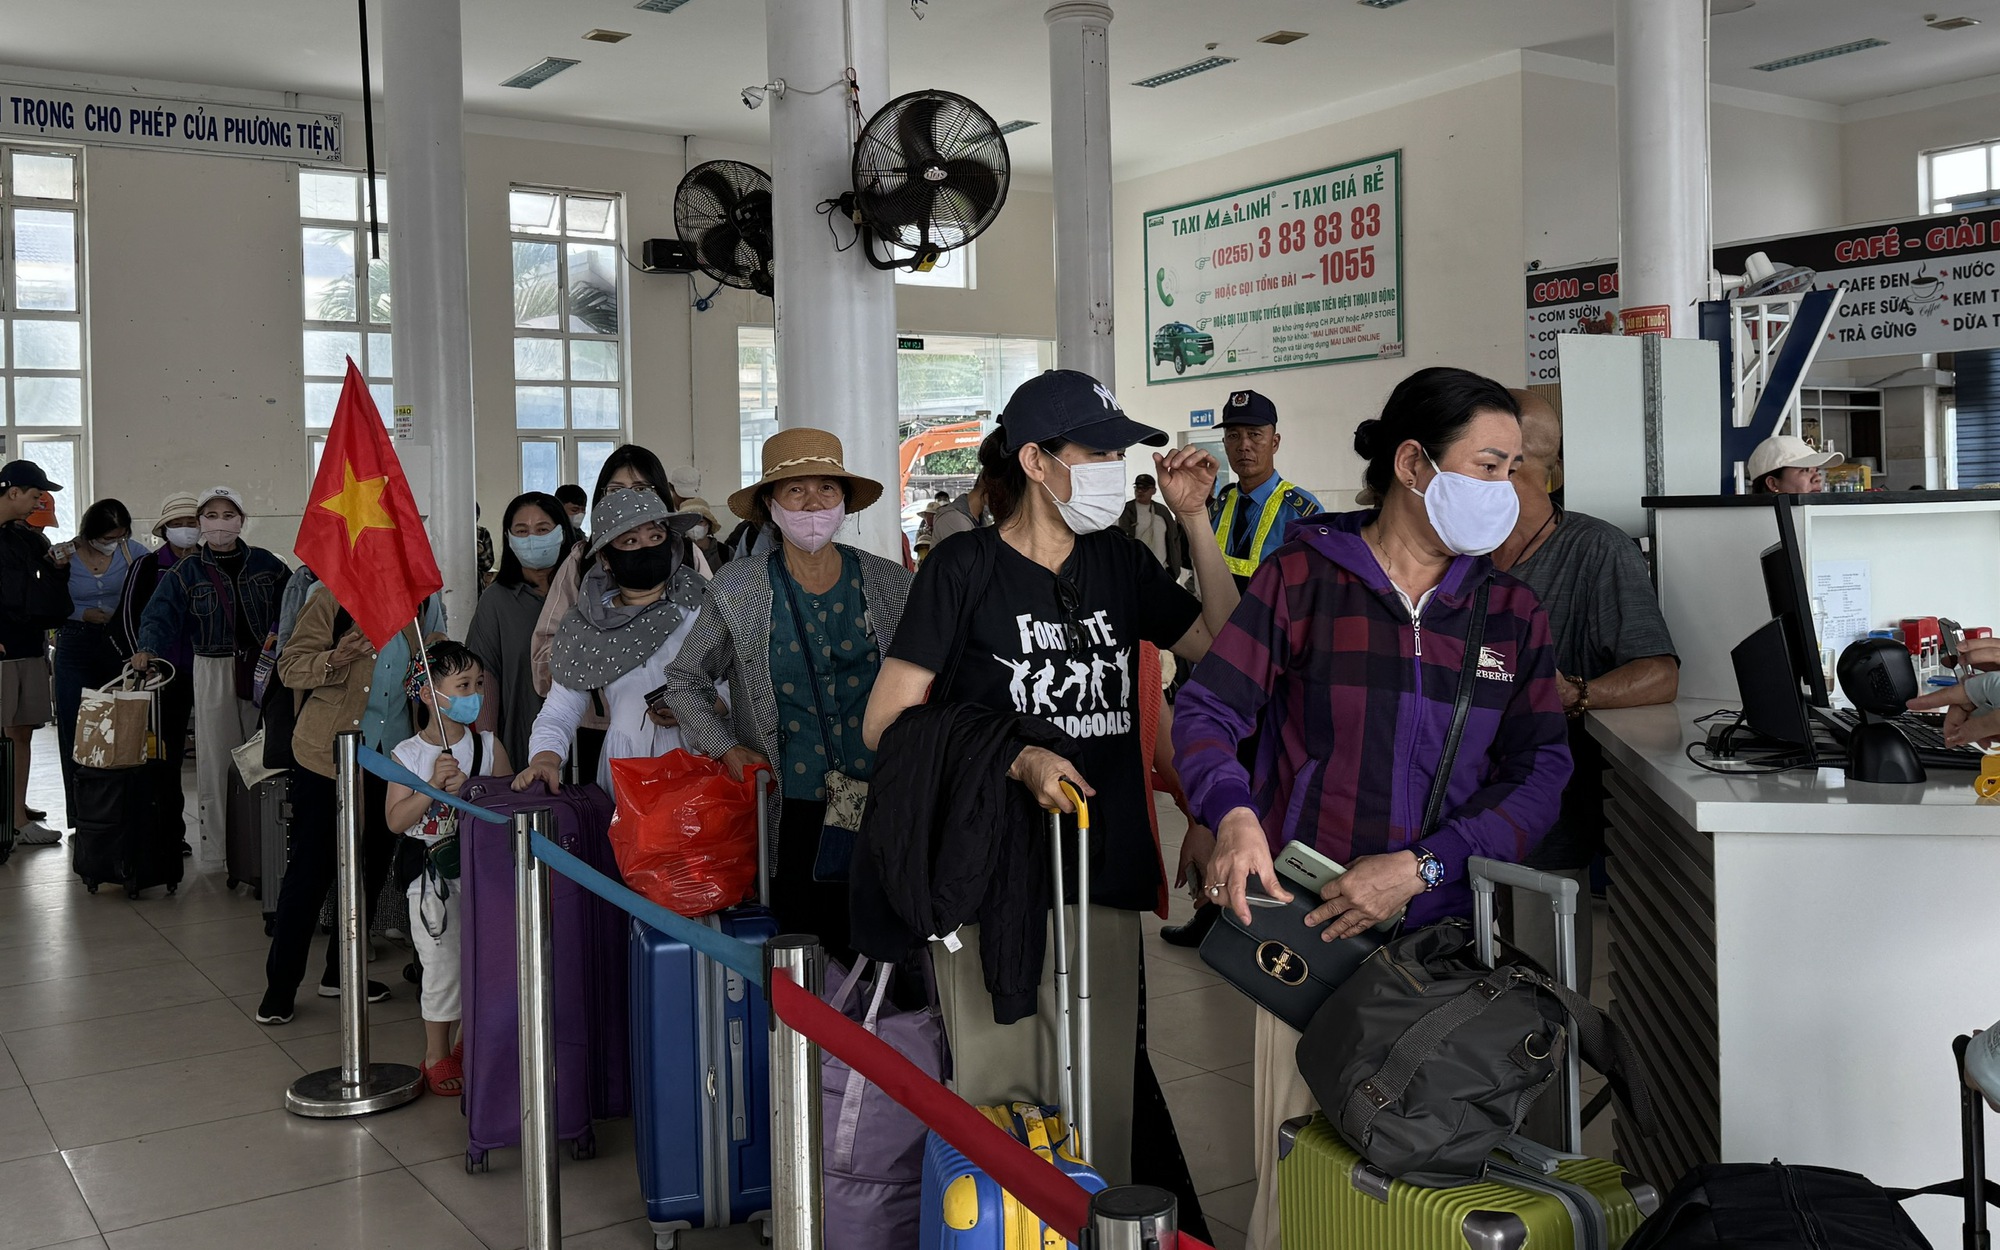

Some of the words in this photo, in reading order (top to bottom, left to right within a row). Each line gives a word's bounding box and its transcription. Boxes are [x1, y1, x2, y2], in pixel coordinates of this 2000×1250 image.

[10, 97, 75, 133] TRỌNG
[84, 103, 122, 134] CHO
[129, 106, 177, 137] PHÉP
[183, 106, 219, 142] CỦA
[224, 115, 292, 148] PHƯƠNG
[297, 119, 335, 155] TIỆN
[1172, 214, 1200, 237] TAXI
[1293, 185, 1327, 210] TAXI
[1332, 173, 1357, 201] GIÁ
[1363, 165, 1384, 194] RẺ
[1212, 242, 1254, 269] (0255)
[1258, 226, 1271, 258] 3
[1278, 219, 1306, 254] 83
[1314, 211, 1342, 247] 83
[1350, 203, 1381, 240] 83
[1835, 227, 1900, 263] CAFÉ
[1925, 217, 1985, 251] GIẢI
[1319, 245, 1375, 286] 1055
[1952, 260, 1995, 280] NƯỚC
[1533, 277, 1579, 302] CƠM
[1839, 276, 1875, 294] CAFE
[1880, 272, 1910, 289] ĐEN
[1839, 301, 1876, 318] CAFE
[1880, 296, 1910, 314] SỮA
[1953, 290, 1986, 307] KEM
[1329, 316, 1345, 325] PLAY
[1360, 311, 1374, 321] APP
[1374, 308, 1396, 319] STORE
[1538, 308, 1566, 323] CƠM
[1569, 304, 1601, 320] SƯỜN
[1953, 313, 1988, 331] DỪA
[1325, 327, 1338, 337] LINH
[1342, 336, 1356, 344] LINH
[1357, 333, 1380, 342] ONLINE
[1538, 328, 1566, 342] CƠ
[1839, 323, 1866, 343] TRÀ
[1871, 321, 1917, 340] GỪNG
[1538, 347, 1557, 360] CƠ
[1016, 609, 1117, 654] FORTTE
[1475, 669, 1515, 682] RBERRY
